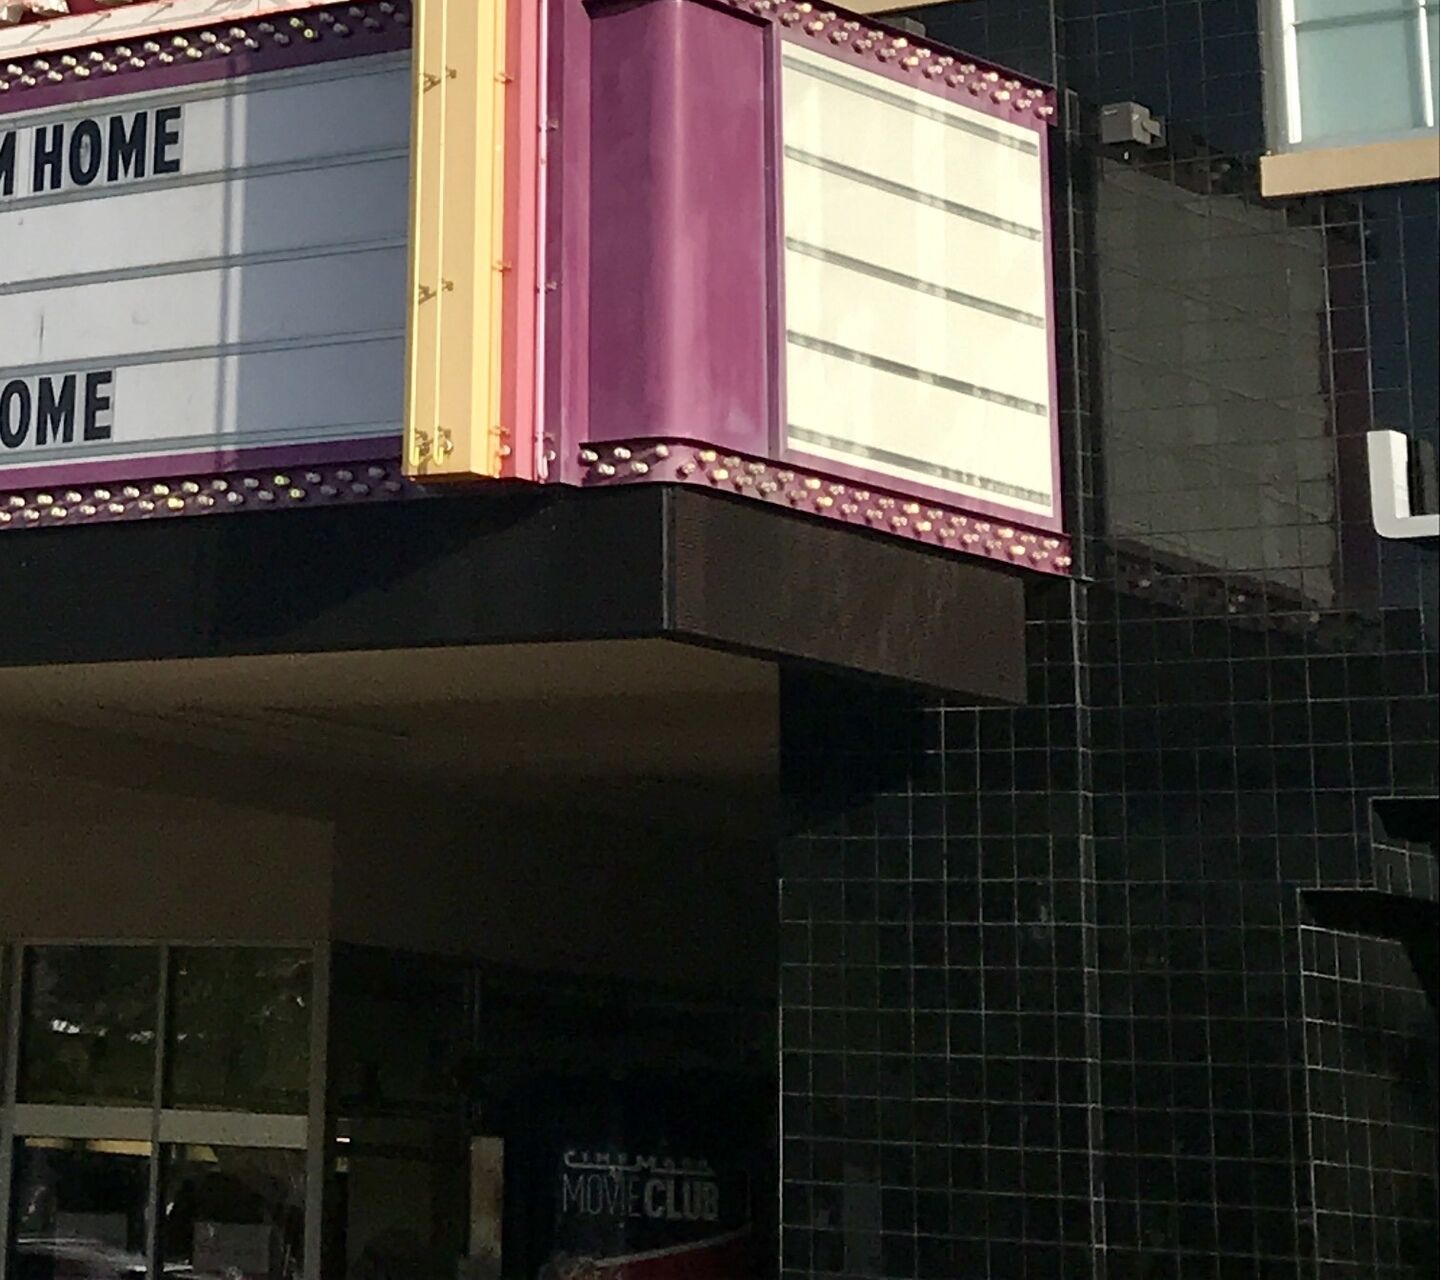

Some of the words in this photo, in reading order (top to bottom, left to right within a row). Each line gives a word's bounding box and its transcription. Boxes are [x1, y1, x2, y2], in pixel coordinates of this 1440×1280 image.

[33, 107, 183, 191] HOME
[562, 1173, 641, 1218] MOVIE
[644, 1177, 720, 1222] CLUB
